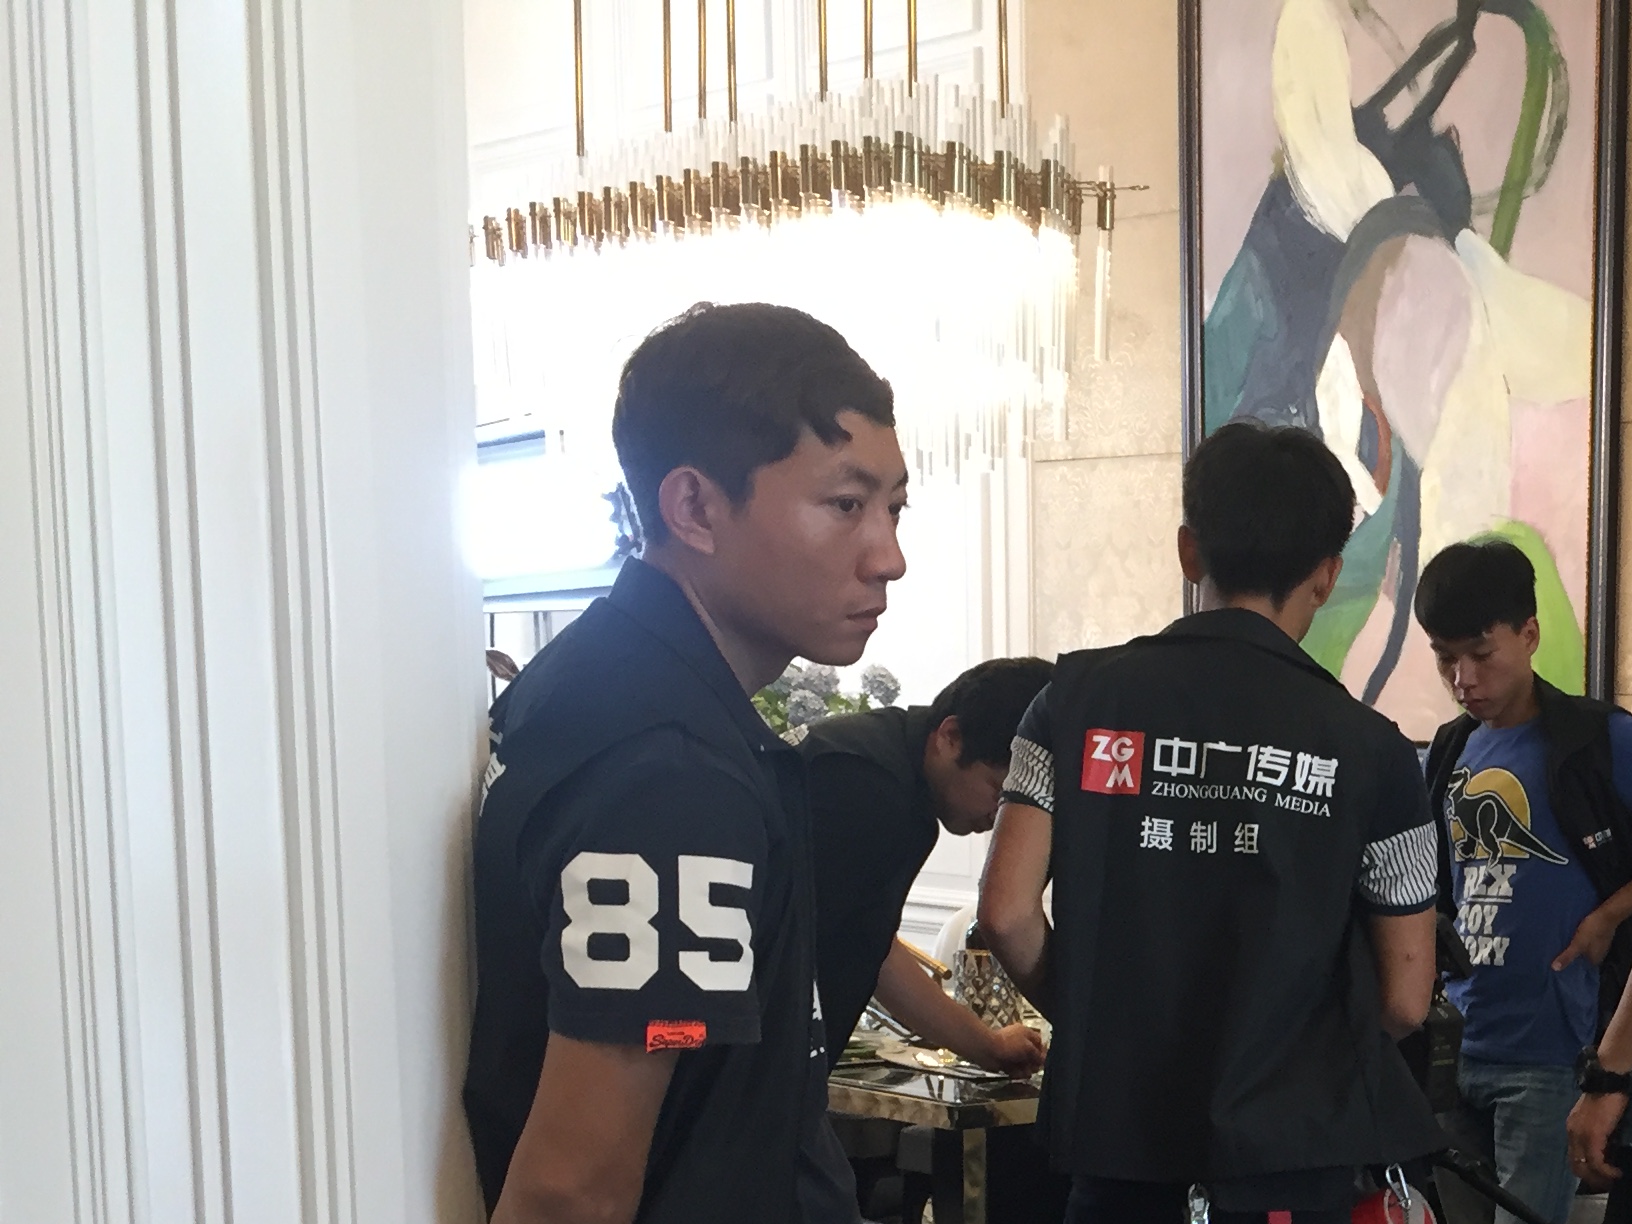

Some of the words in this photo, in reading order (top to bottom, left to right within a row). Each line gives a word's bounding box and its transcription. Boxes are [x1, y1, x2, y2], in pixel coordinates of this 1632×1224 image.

[1153, 737, 1339, 798] 中广传媒
[1151, 781, 1268, 803] ZHONGGUANG
[1274, 792, 1332, 818] MEDIA
[1139, 815, 1260, 854] 摄制组
[561, 851, 754, 991] 85
[1460, 936, 1510, 966] ORY
